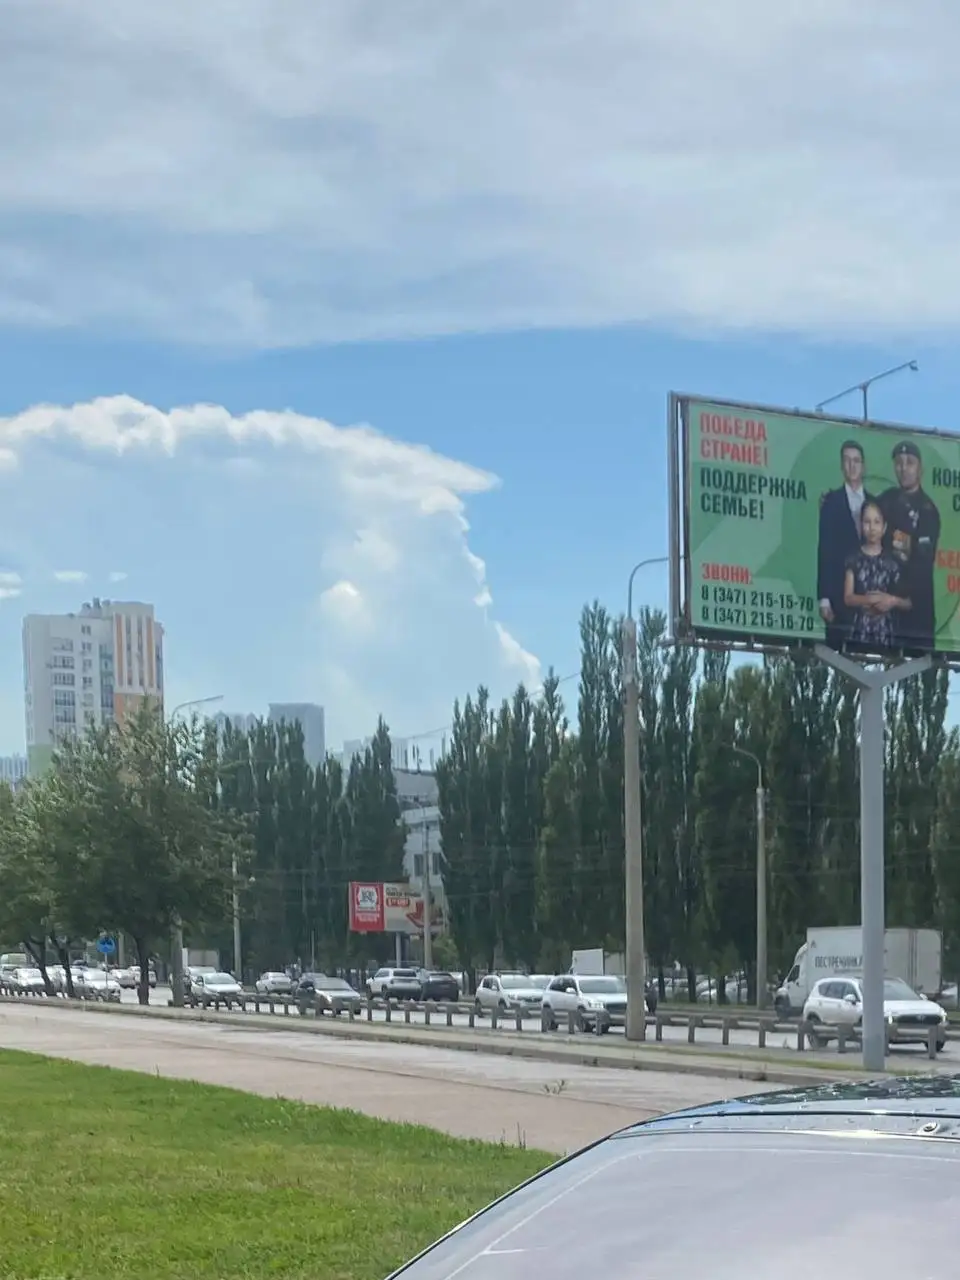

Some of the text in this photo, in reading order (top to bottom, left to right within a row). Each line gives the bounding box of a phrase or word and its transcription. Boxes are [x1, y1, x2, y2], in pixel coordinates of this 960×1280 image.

[700, 412, 767, 442] ПОБЕДА
[700, 439, 768, 467] СТРАНЕ!
[700, 467, 807, 502] ПОДДЕРЖКА
[700, 492, 764, 520] СЕМЬЕ!
[714, 586, 746, 605] (347)
[714, 607, 746, 626] (347)
